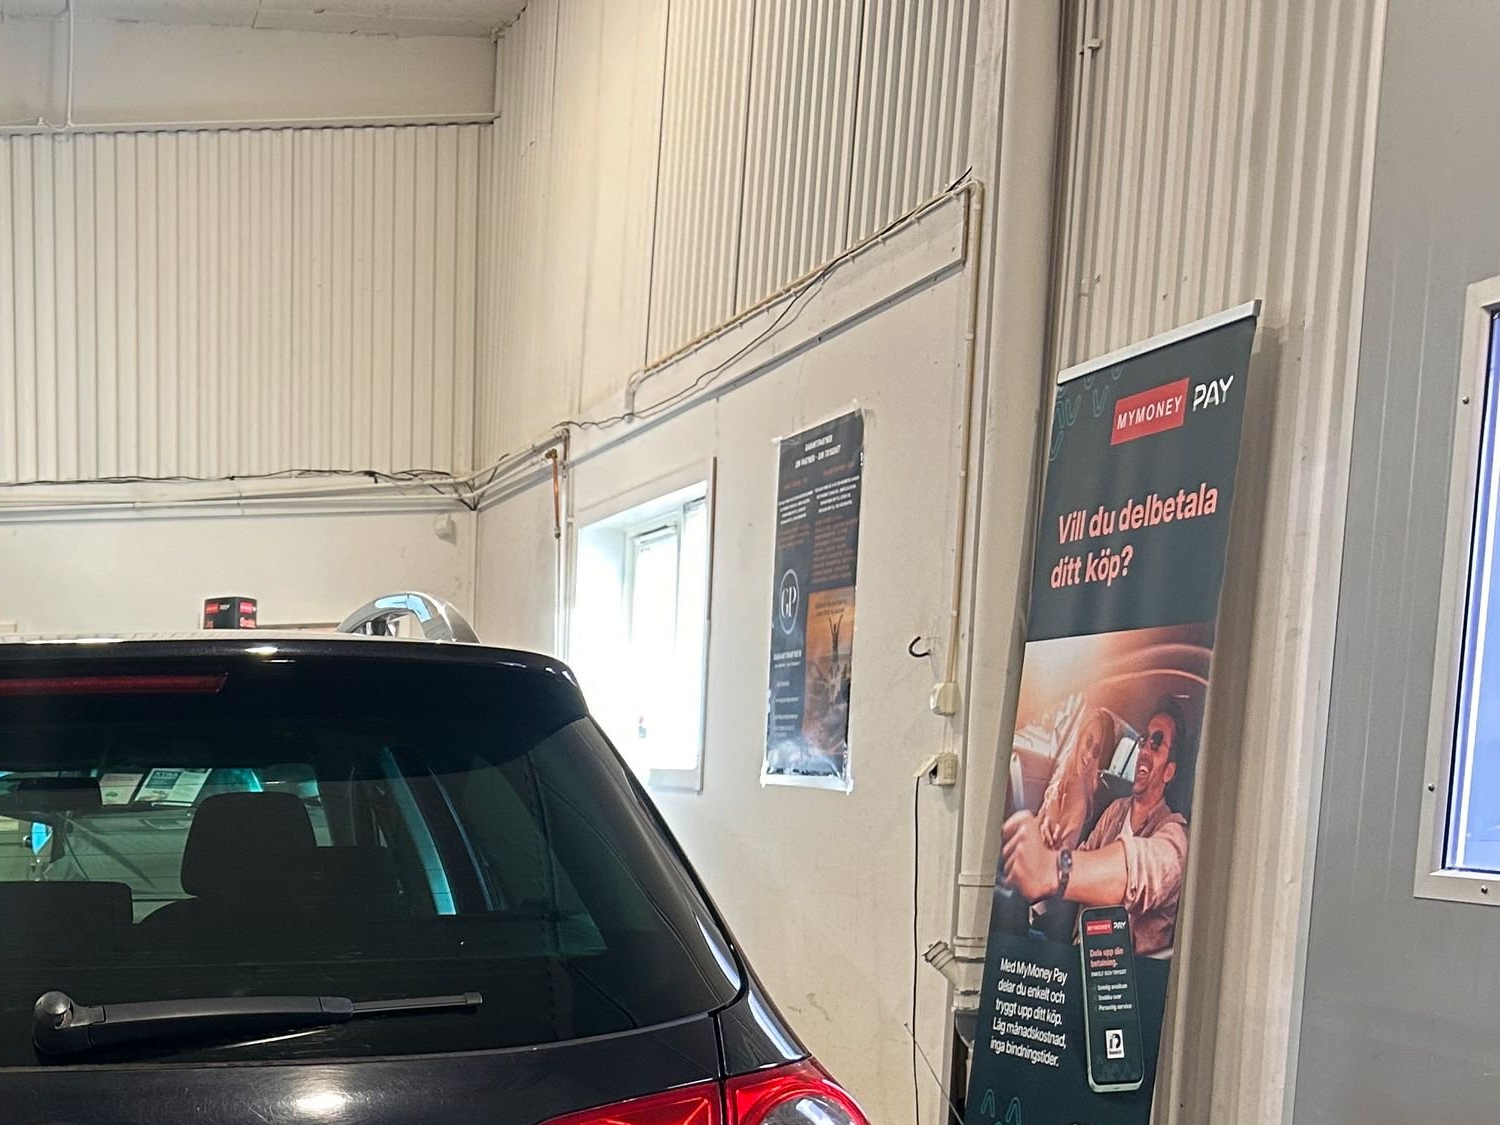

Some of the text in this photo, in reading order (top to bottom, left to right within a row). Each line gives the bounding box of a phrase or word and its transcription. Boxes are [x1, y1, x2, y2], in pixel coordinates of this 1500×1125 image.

[1116, 375, 1234, 430] MYMONEY PAY
[1059, 482, 1218, 544] Vill du delbetala
[1050, 545, 1134, 588] ditt köp?
[1000, 958, 1068, 986] Med MyMoney Pay
[998, 979, 1065, 1004] delar du enkelt och
[995, 998, 1063, 1027] tryggt upp ditt köp.
[993, 1016, 1067, 1049] Låg månadskostnad,
[990, 1035, 1059, 1067] inga bindningstider.
